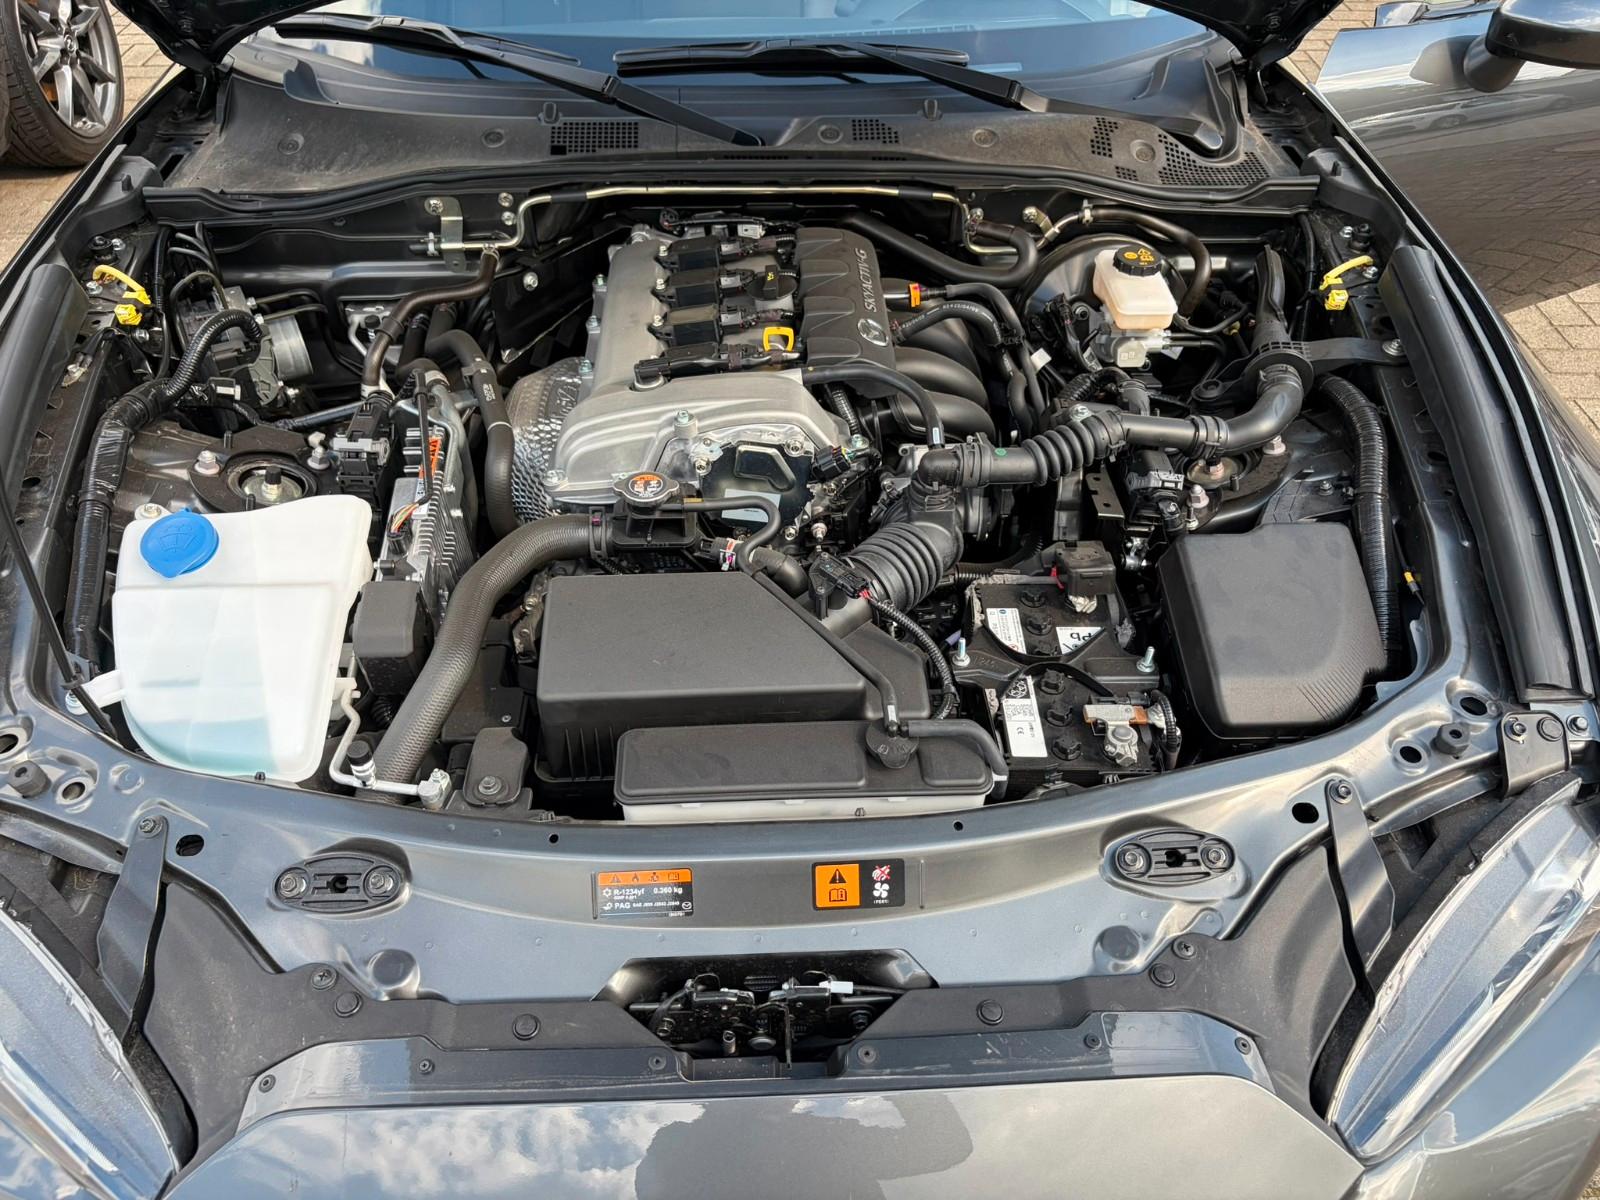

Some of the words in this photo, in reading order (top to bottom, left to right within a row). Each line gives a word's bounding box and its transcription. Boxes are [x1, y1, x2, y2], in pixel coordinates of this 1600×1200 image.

[855, 248, 877, 312] SKYACTIV-G
[613, 888, 645, 896] R-1234yf
[673, 886, 683, 894] kg
[614, 902, 631, 910] PAG
